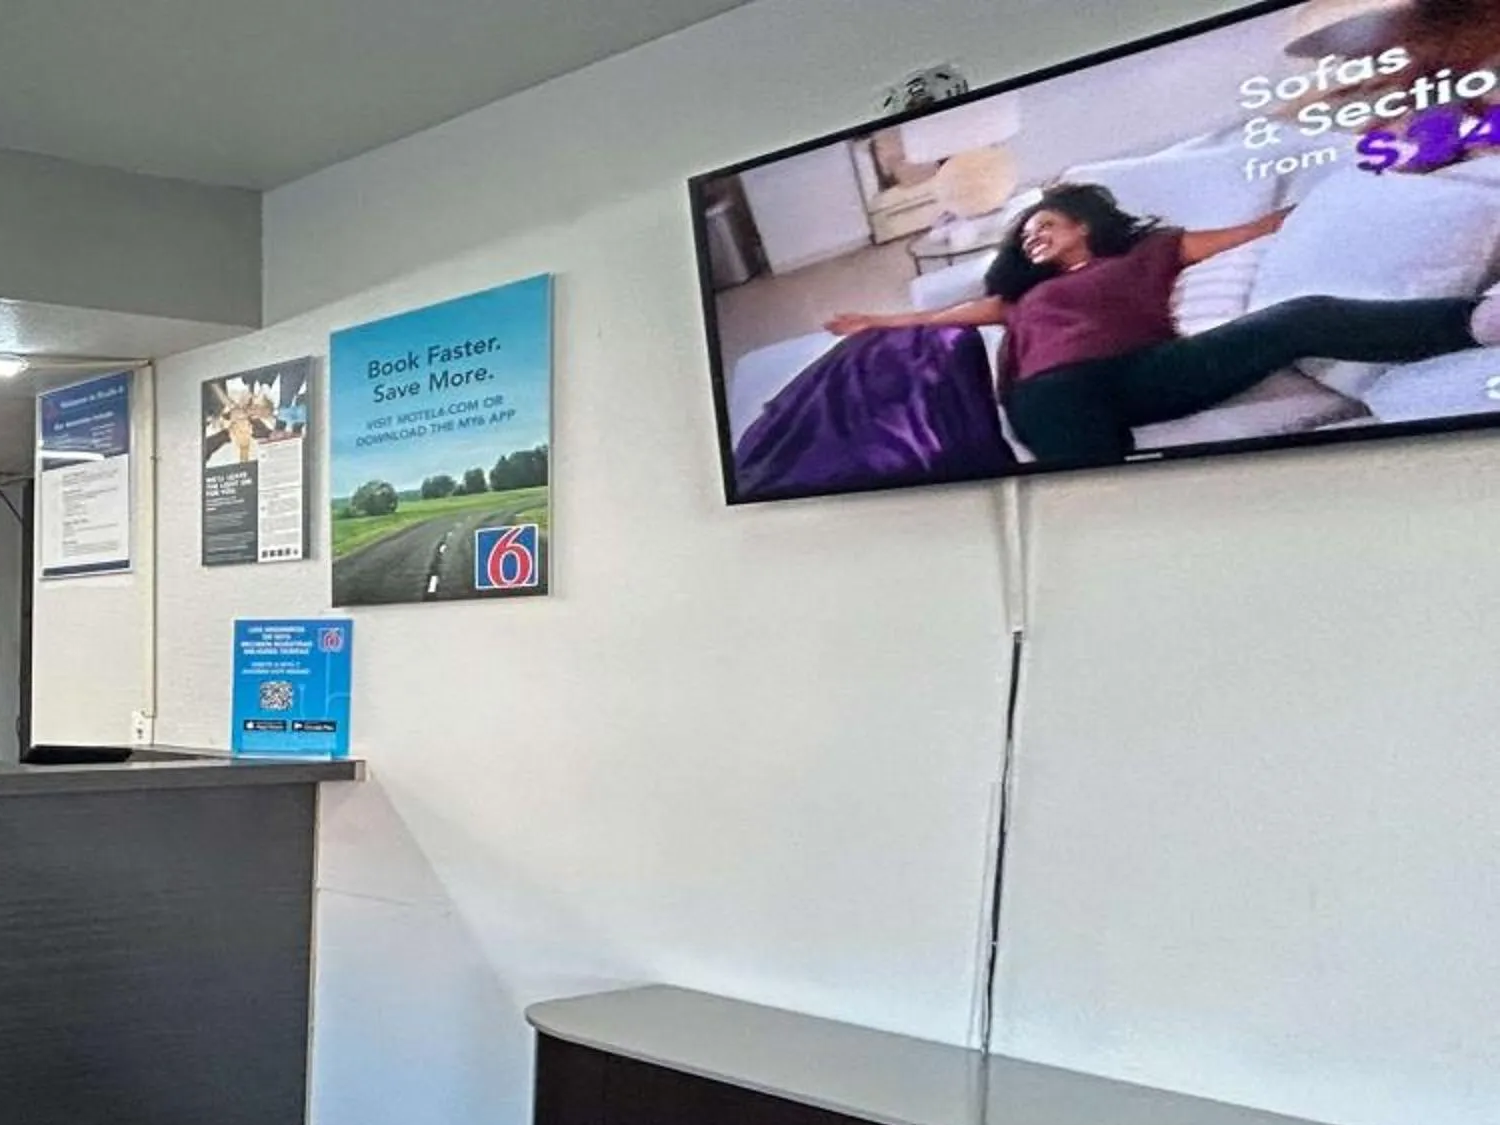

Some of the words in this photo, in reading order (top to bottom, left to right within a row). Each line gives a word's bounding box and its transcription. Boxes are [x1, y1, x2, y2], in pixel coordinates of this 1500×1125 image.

[1239, 47, 1412, 109] Sofas
[1243, 116, 1281, 149] &
[1244, 146, 1337, 182] from
[367, 352, 420, 379] Book
[427, 336, 501, 366] Faster.
[373, 381, 421, 403] Save
[429, 366, 495, 393] More.
[356, 425, 427, 448] DOWNLOAD
[431, 420, 454, 435] THE
[488, 408, 517, 425] APP
[366, 415, 393, 430] VISIT
[483, 395, 504, 409] OR
[487, 525, 533, 589] 6
